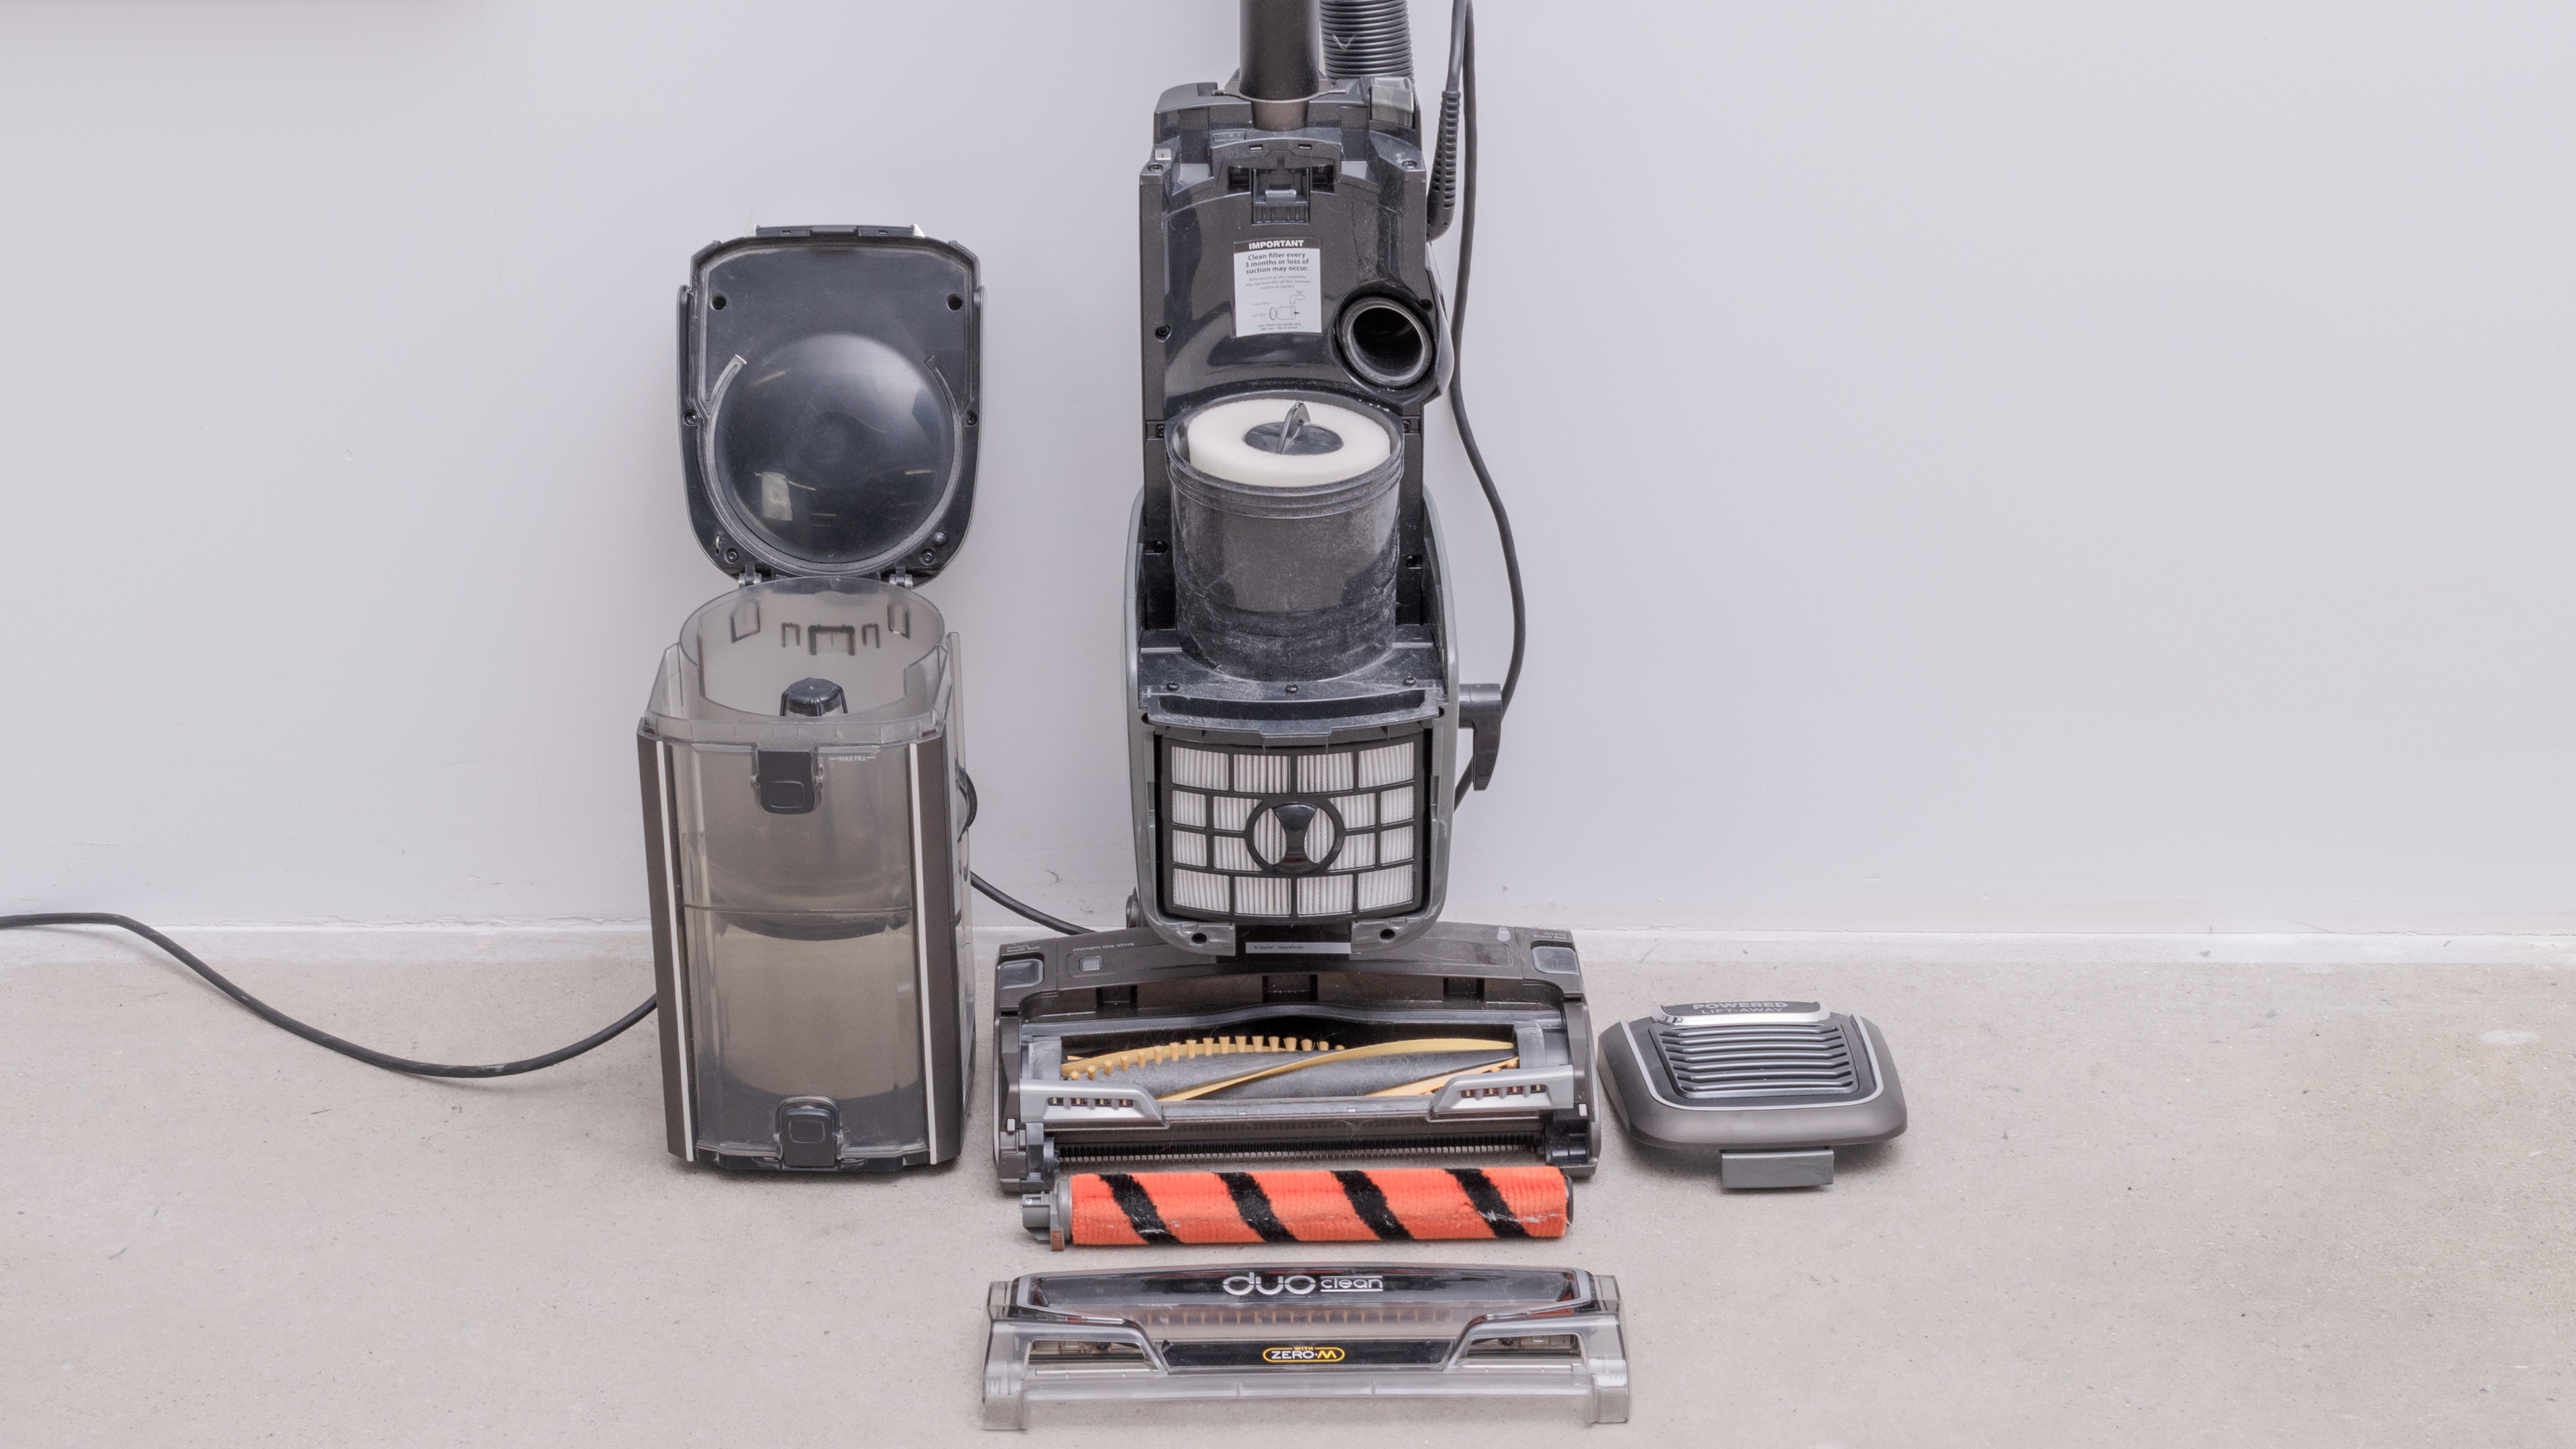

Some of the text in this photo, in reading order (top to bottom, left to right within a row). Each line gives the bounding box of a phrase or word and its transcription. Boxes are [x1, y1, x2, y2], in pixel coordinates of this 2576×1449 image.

[1248, 239, 1304, 250] IMPORTANT
[1246, 266, 1271, 274] suction
[1693, 1002, 1788, 1010] POWERED
[1320, 1277, 1383, 1289] clean
